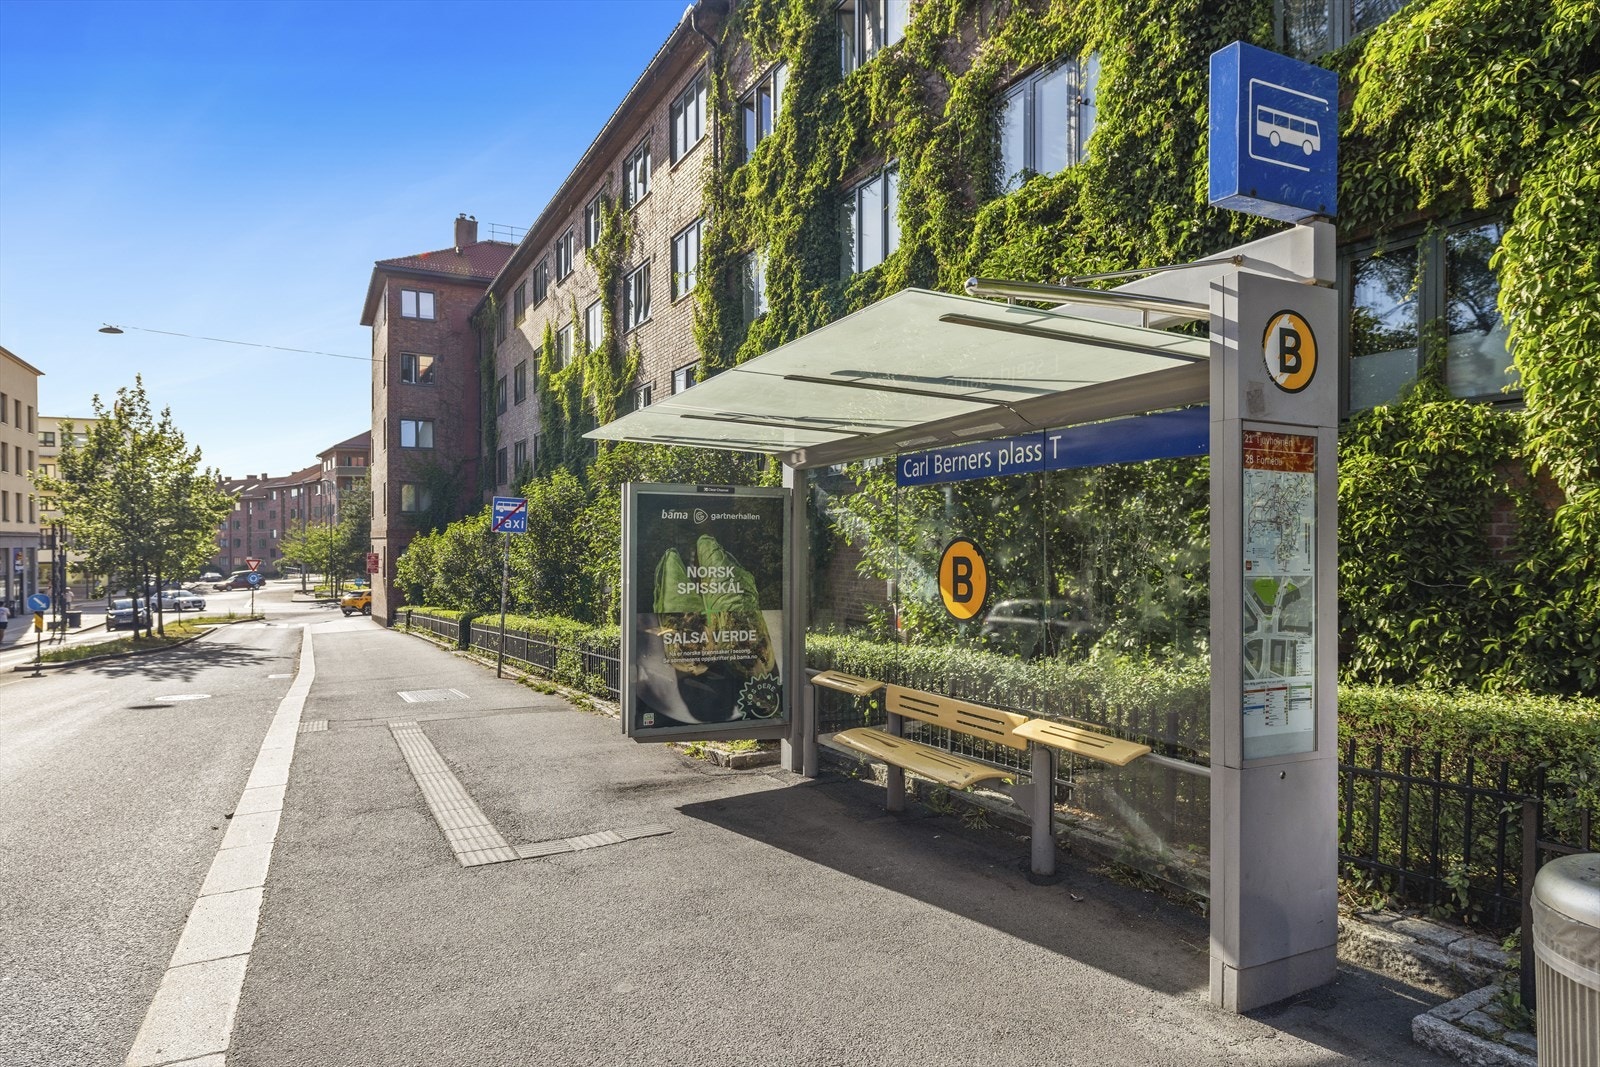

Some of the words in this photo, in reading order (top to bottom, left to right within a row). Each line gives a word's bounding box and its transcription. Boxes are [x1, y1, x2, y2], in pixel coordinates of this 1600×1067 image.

[1279, 327, 1302, 374] B
[1245, 434, 1253, 443] 21
[903, 455, 929, 478] Carl
[934, 449, 992, 474] Berners
[998, 441, 1042, 471] plass
[1049, 435, 1062, 459] T
[1245, 454, 1254, 464] 28
[495, 515, 525, 529] Taxi
[711, 512, 760, 521] gartnerhallen
[687, 566, 735, 578] NORSK
[677, 579, 744, 595] SPISSKÅL
[952, 556, 974, 604] B
[663, 632, 709, 645] SALSA
[713, 629, 757, 643] VERDE
[757, 682, 776, 692] DERE
